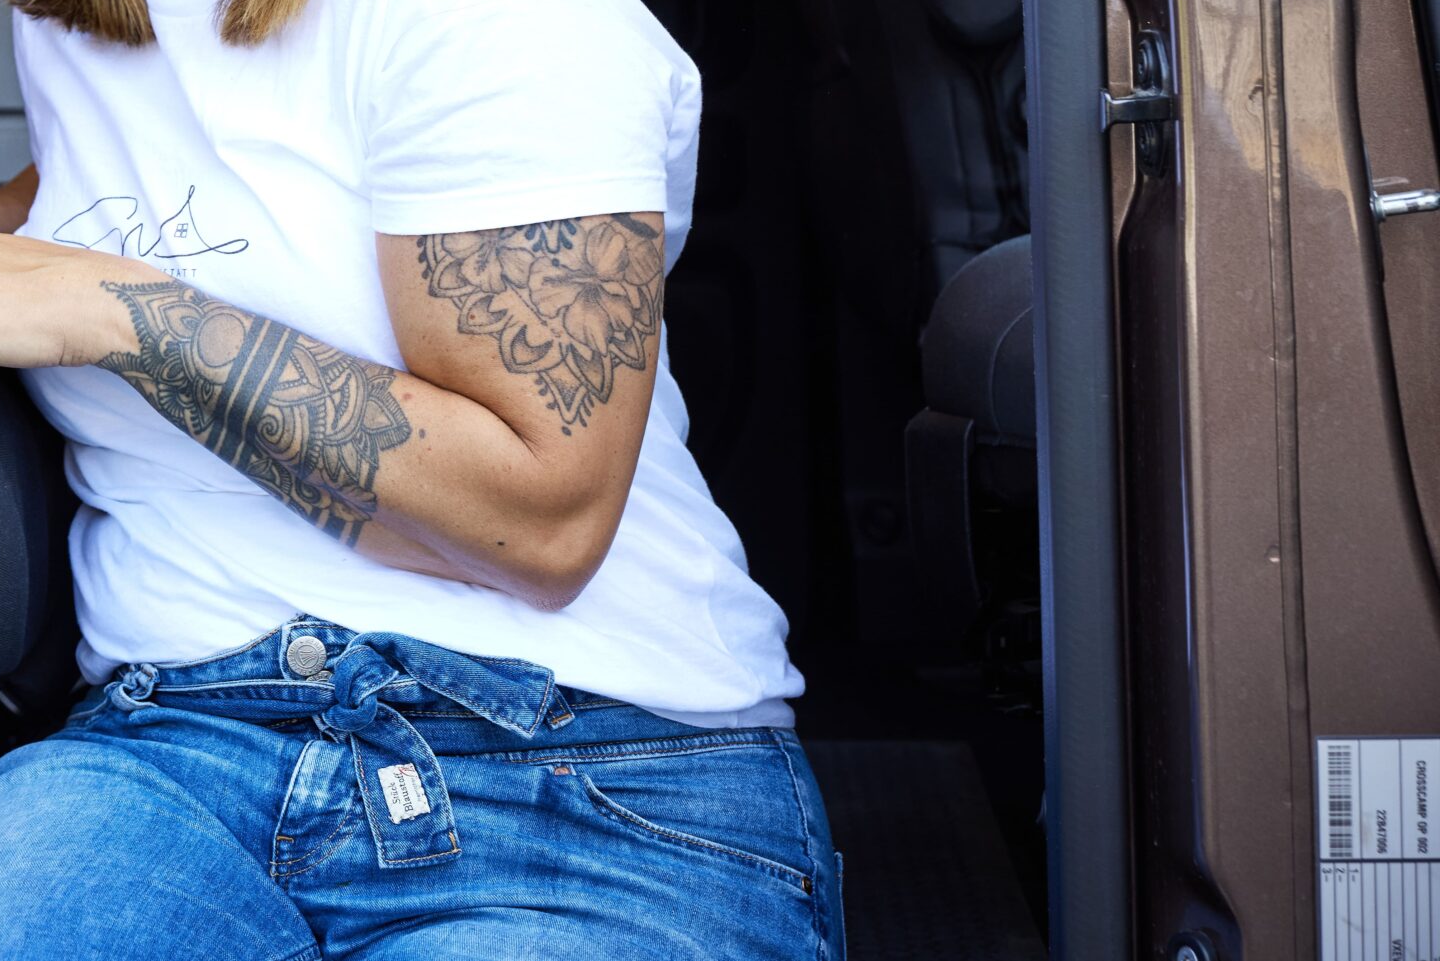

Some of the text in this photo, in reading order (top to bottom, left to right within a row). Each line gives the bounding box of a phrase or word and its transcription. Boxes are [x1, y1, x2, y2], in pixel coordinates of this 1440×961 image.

[393, 772, 414, 812] Blaustoff
[1416, 760, 1427, 819] CROSSCAMP
[1417, 821, 1428, 835] OP
